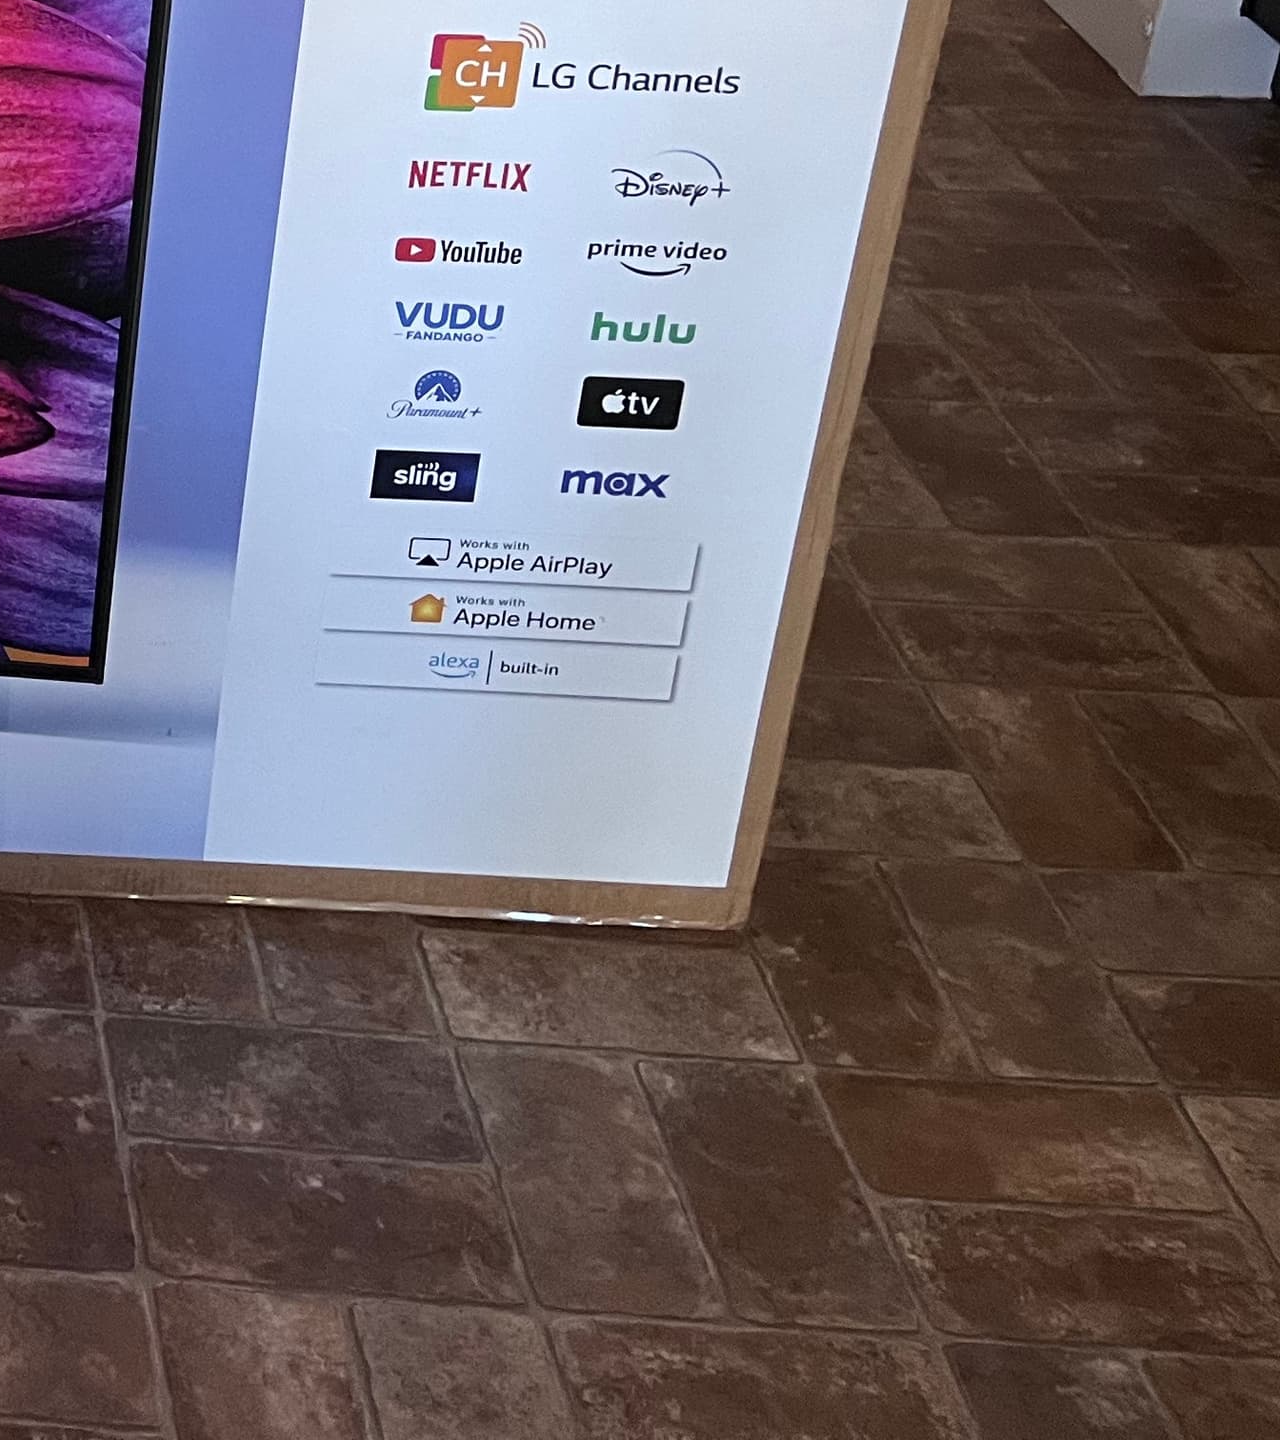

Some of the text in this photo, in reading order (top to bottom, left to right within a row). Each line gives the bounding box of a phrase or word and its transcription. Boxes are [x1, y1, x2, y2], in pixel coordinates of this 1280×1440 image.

[454, 60, 507, 88] CH
[532, 62, 740, 94] LG Channels
[408, 160, 532, 192] NETFLIX
[440, 240, 522, 265] YouTube
[587, 239, 727, 261] prime video
[395, 301, 505, 331] VUDU
[591, 311, 697, 345] hulu
[406, 331, 484, 343] FANDANGO
[393, 463, 457, 491] sling
[560, 469, 670, 498] max
[460, 539, 530, 551] Works with
[456, 552, 613, 580] Apple AirPlay
[456, 596, 526, 608] Works with
[453, 609, 596, 631] Apple Home
[428, 653, 479, 669] alexa
[500, 661, 559, 676] built-in
